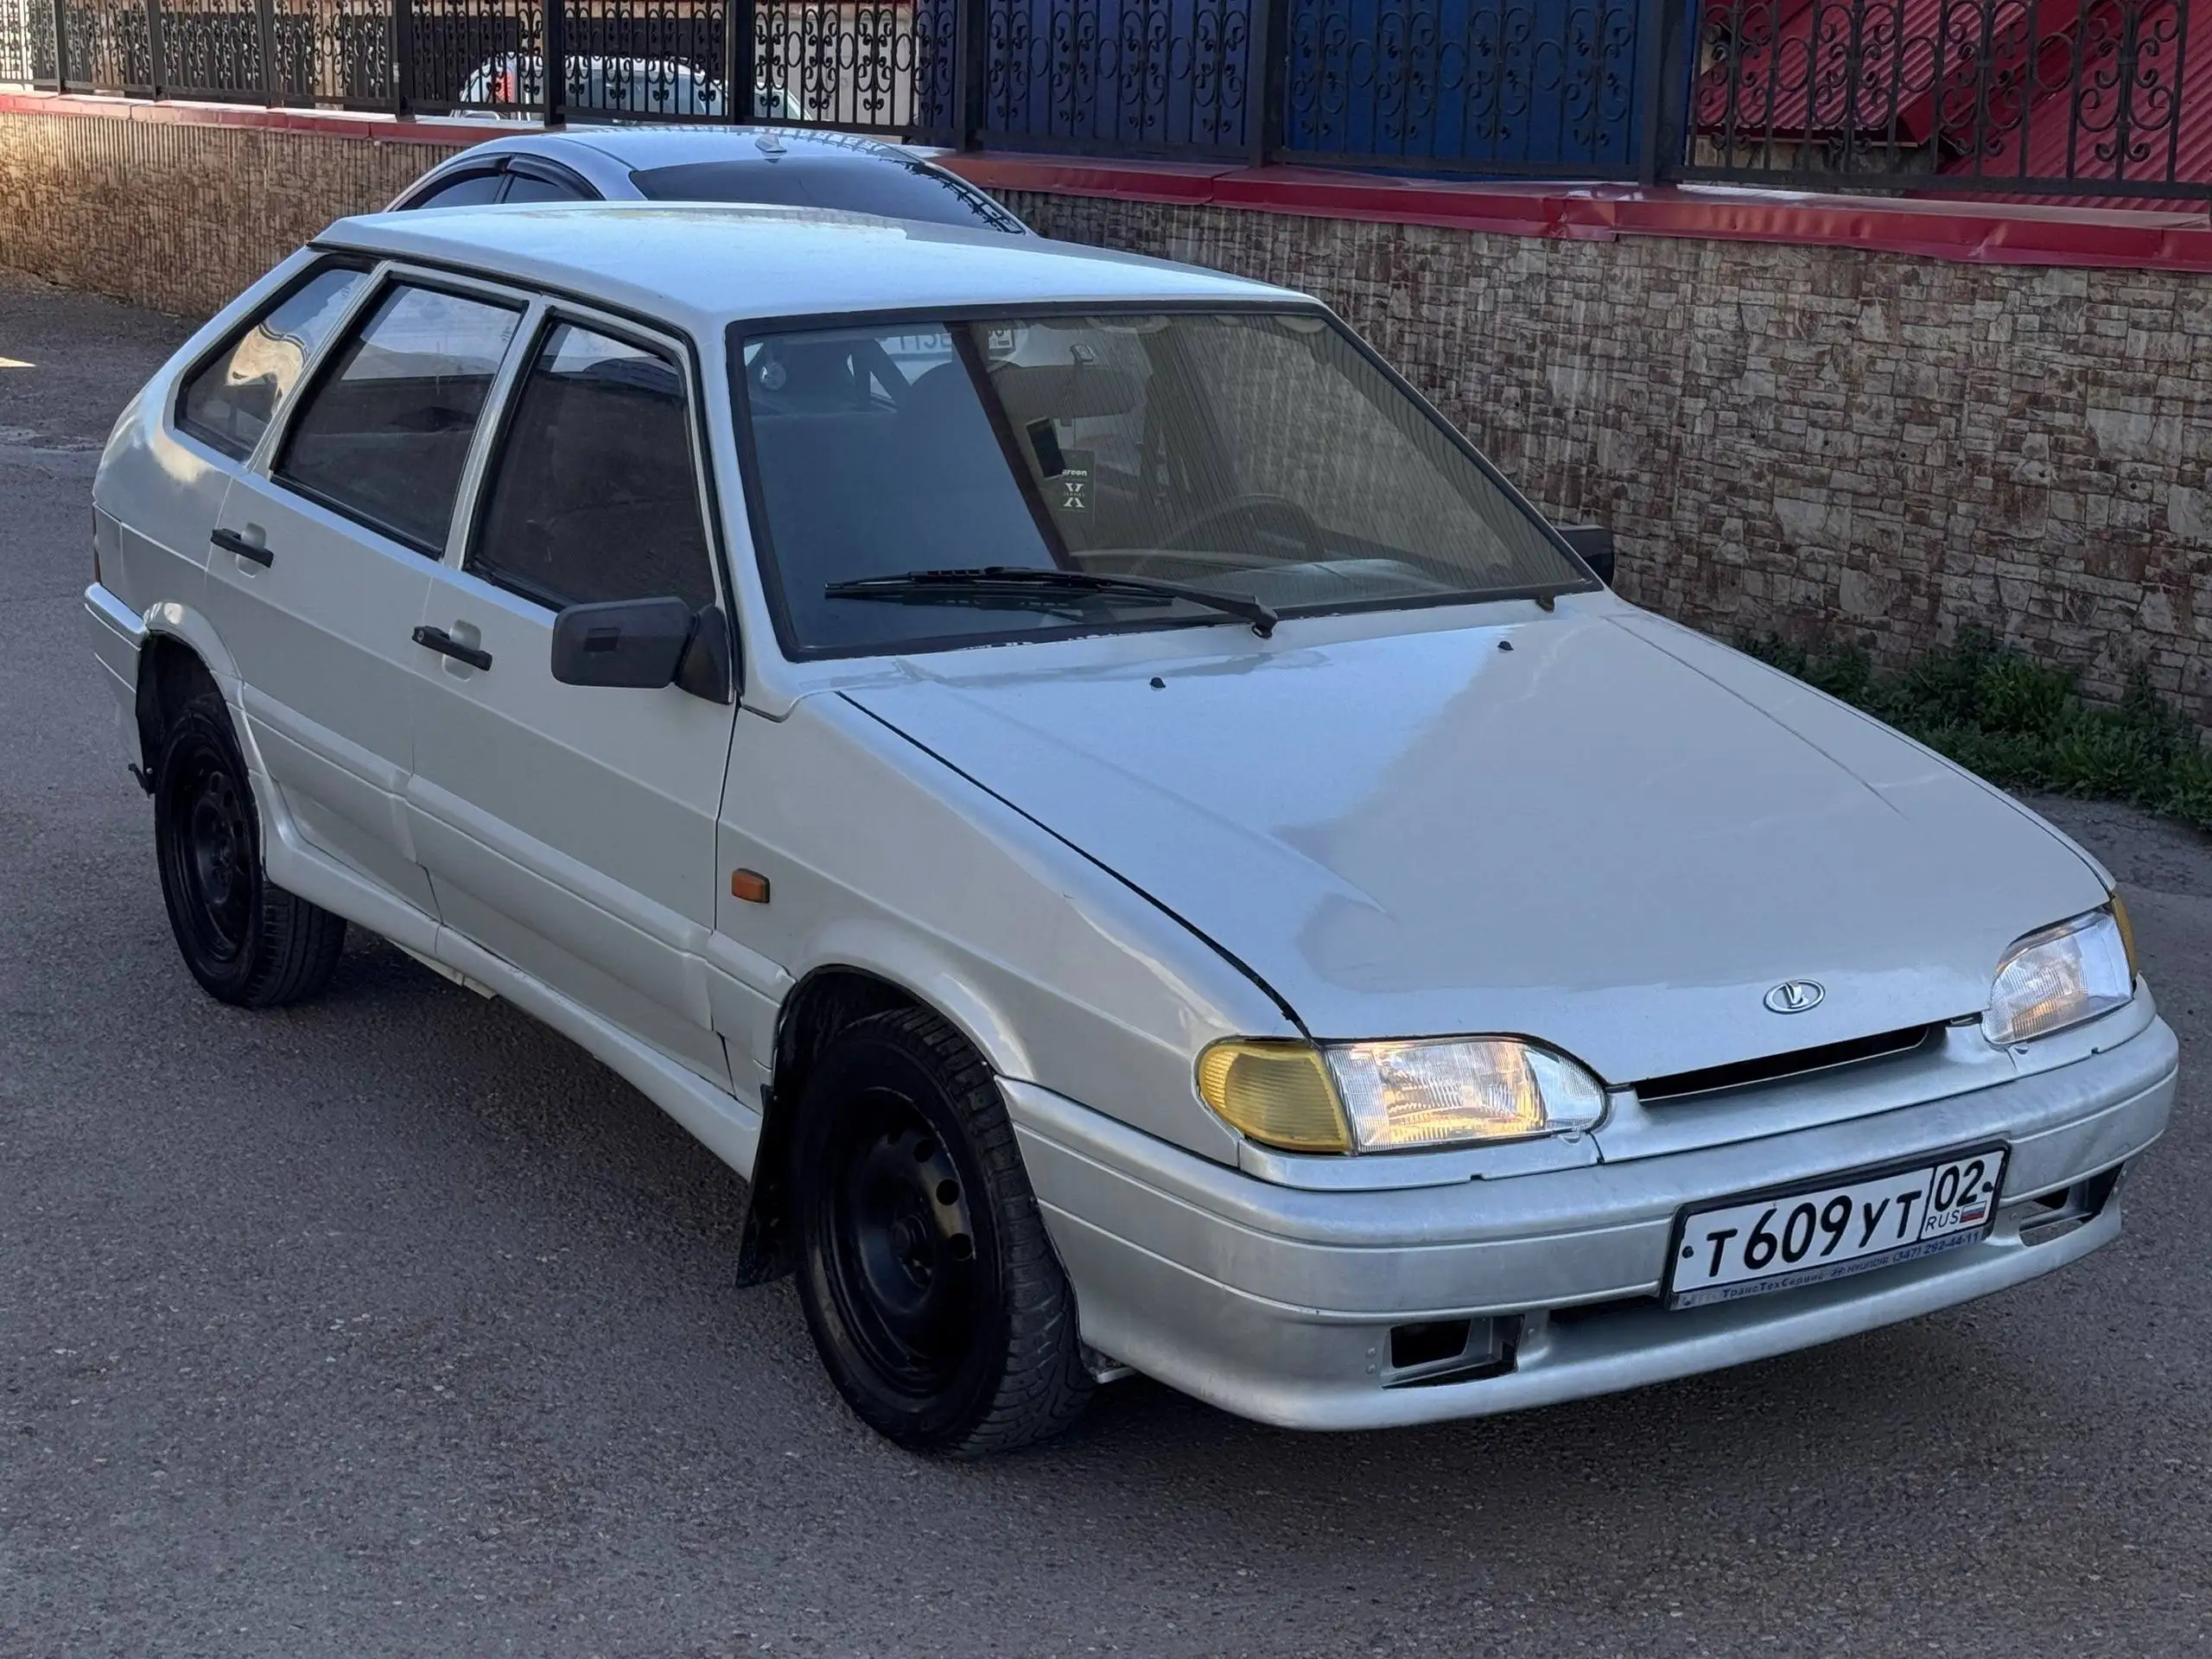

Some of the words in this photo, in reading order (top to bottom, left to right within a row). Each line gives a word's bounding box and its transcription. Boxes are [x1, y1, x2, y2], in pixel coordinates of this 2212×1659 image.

[1706, 1190, 1923, 1278] Т609УТ
[1934, 1159, 1985, 1212] 02
[1923, 1208, 1961, 1233] RUS
